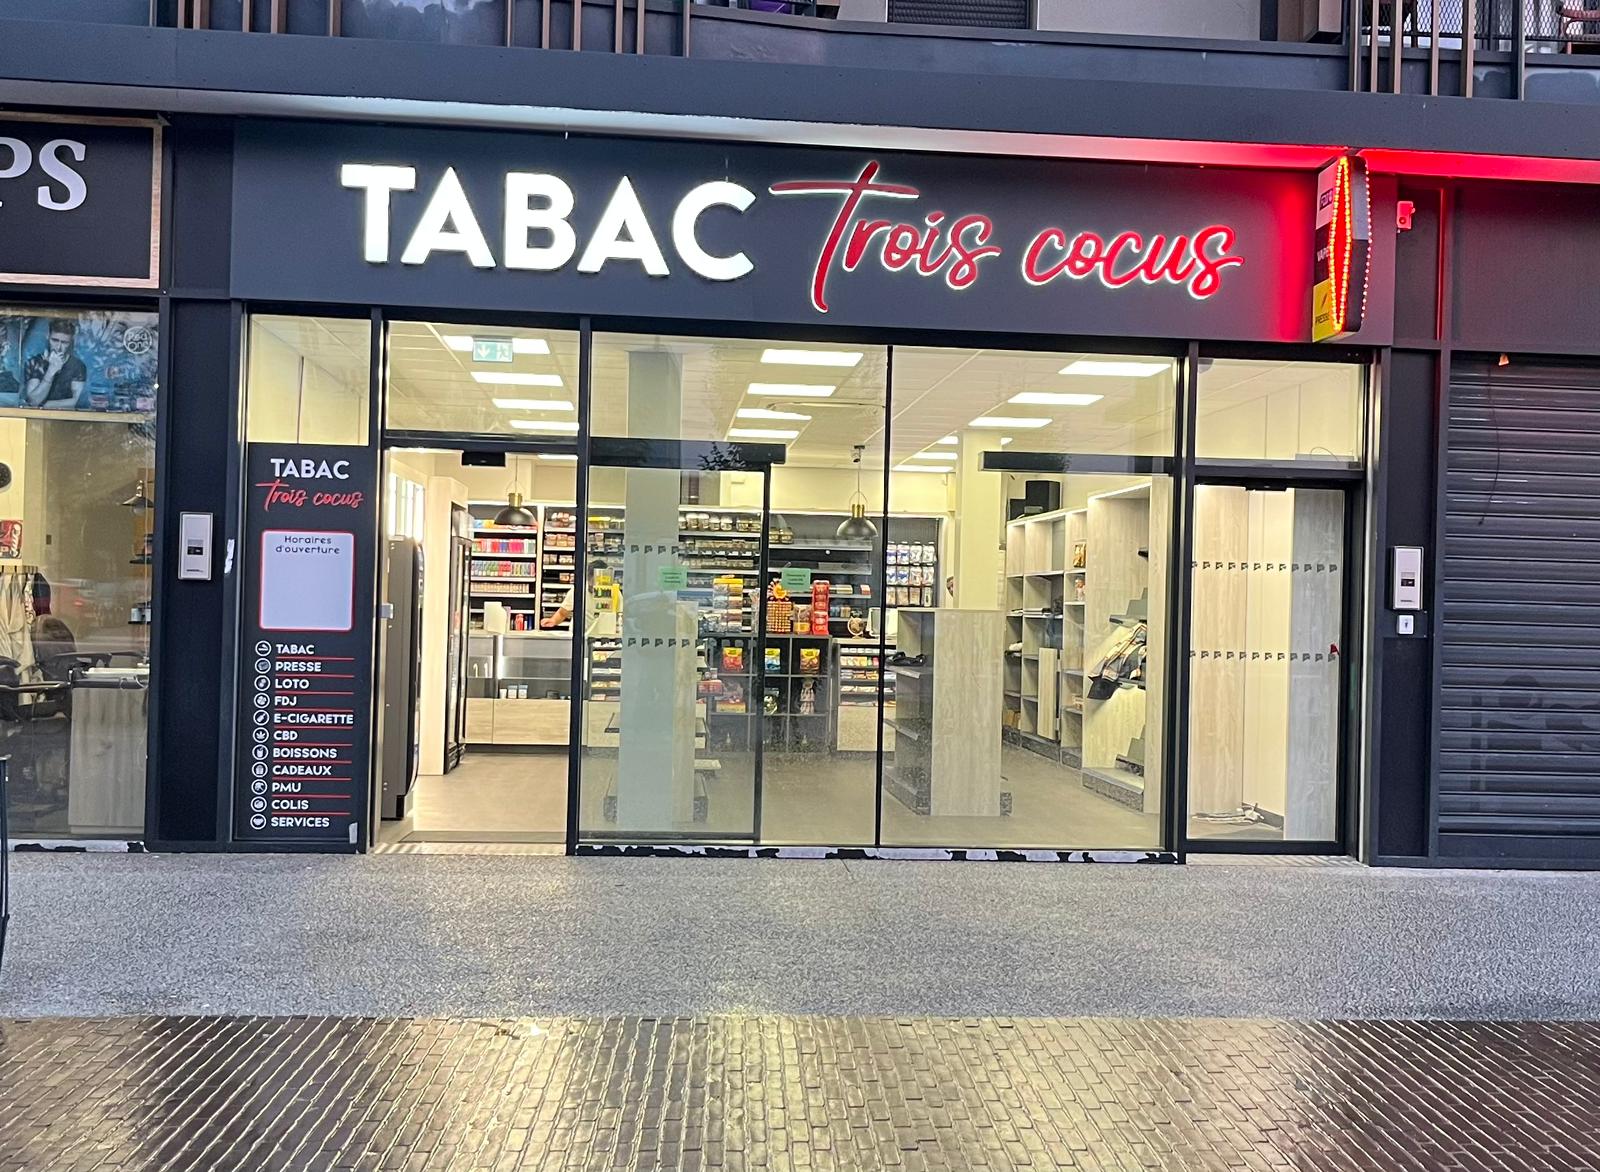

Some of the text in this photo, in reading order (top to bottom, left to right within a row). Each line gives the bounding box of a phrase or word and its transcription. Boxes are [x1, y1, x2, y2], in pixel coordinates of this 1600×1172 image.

[340, 161, 1244, 314] TABAC Trois cocus
[270, 458, 350, 480] TABAC
[256, 479, 364, 512] Trois cocus
[284, 535, 332, 544] Horaires
[275, 545, 340, 554] d'ouverture
[275, 644, 315, 655] TABAC
[275, 661, 322, 672] PRESSE
[274, 678, 310, 689] LOTO
[273, 695, 297, 706] FDJ
[273, 713, 354, 724] E-CIGARETTE
[273, 730, 298, 741] CBD
[272, 747, 337, 758] BOISSONS
[272, 764, 332, 775] CADEAUX
[271, 782, 302, 793] PMU
[271, 799, 310, 810] COLIS
[270, 816, 330, 827] SERVICES
